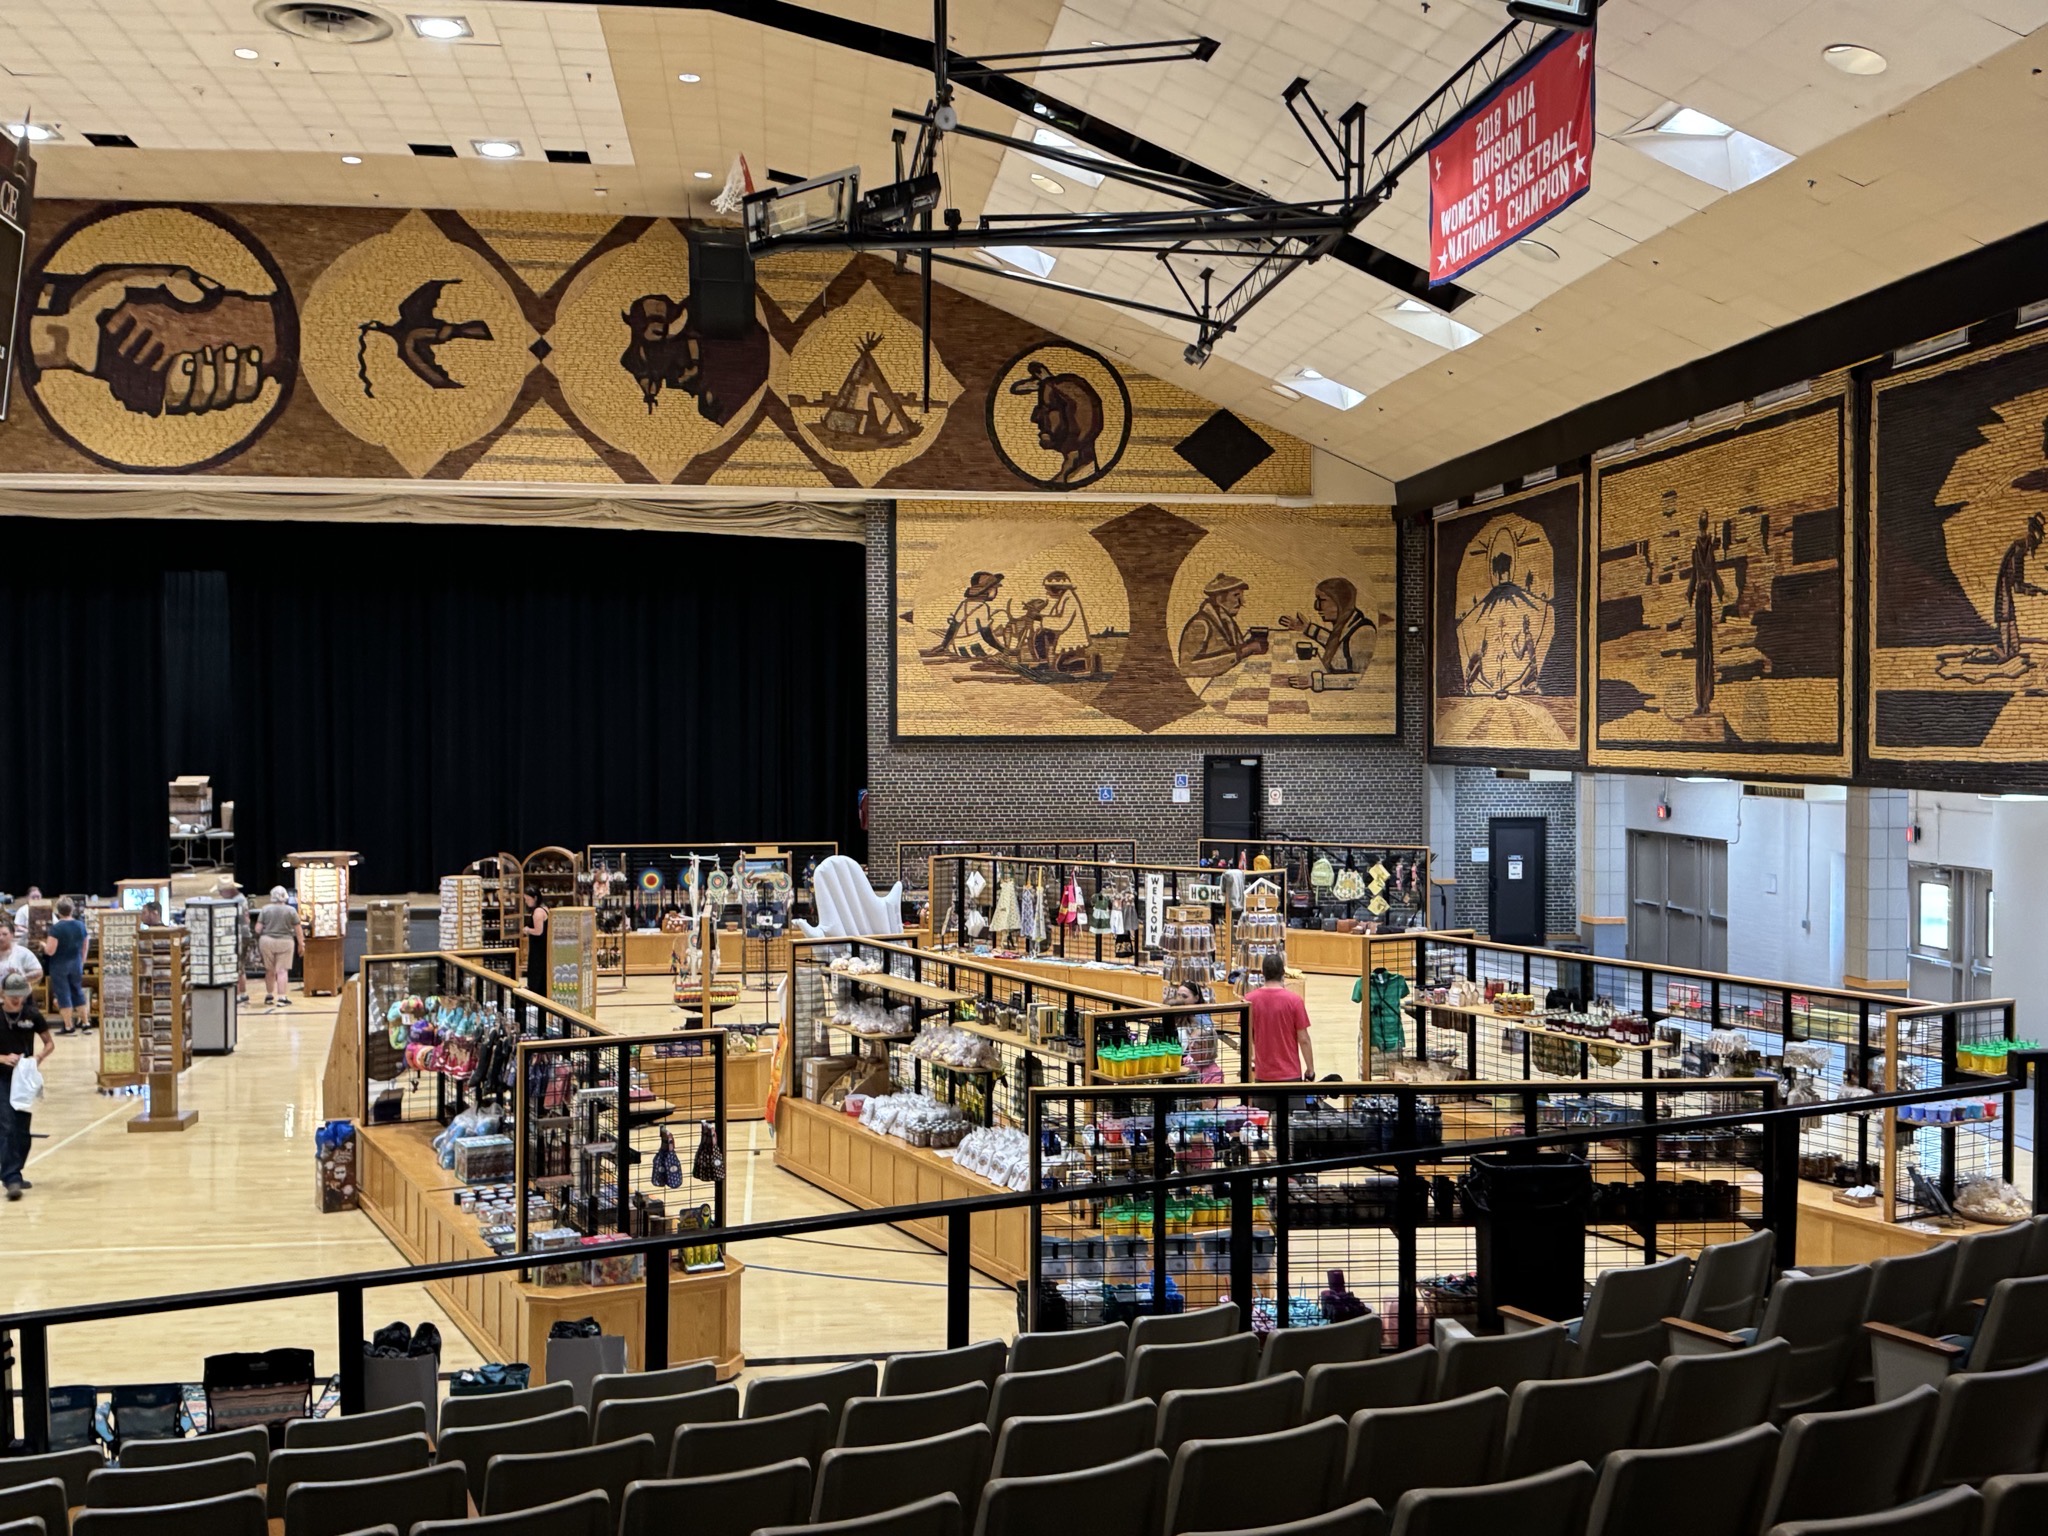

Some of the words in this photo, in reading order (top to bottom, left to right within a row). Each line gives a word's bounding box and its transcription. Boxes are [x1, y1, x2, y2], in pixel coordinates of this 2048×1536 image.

[1472, 126, 1521, 185] DIVISION
[1528, 113, 1537, 145] II
[1476, 108, 1501, 150] 2018
[1507, 81, 1535, 126] NAIA
[1440, 183, 1490, 238] WOMEN'S
[1495, 121, 1578, 203] BASKETBALL
[1447, 212, 1501, 265] NATIONAL
[1506, 160, 1570, 230] CHAMPION
[1151, 877, 1159, 943] WELCOME
